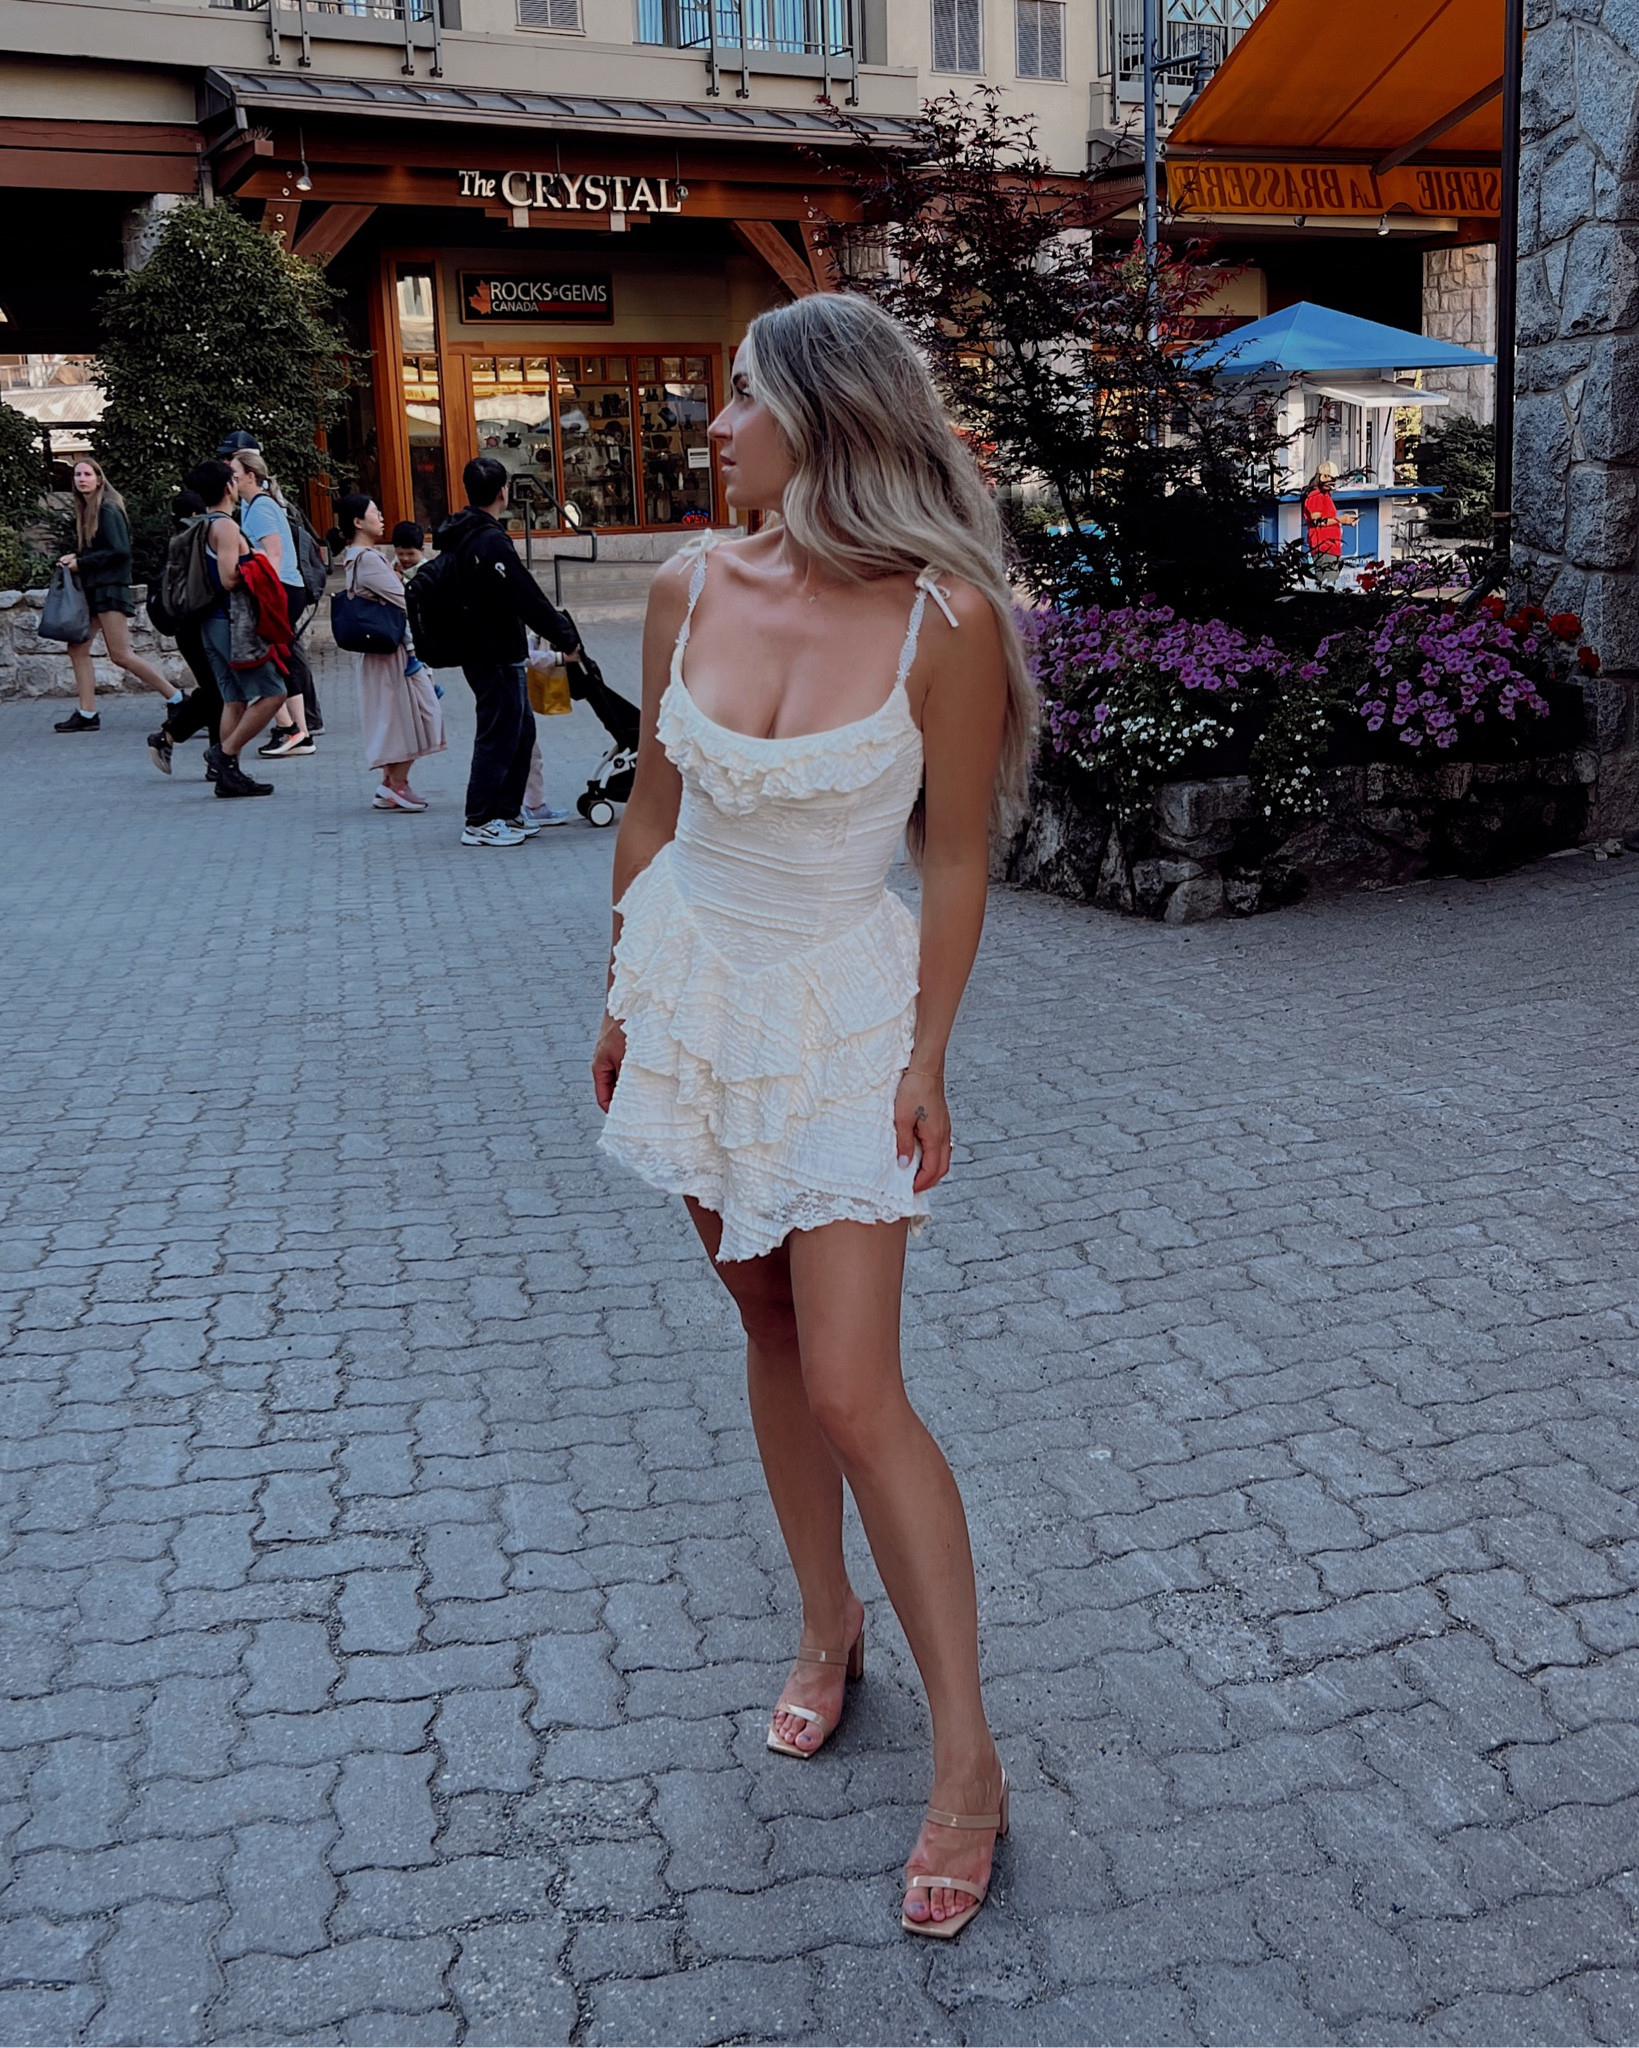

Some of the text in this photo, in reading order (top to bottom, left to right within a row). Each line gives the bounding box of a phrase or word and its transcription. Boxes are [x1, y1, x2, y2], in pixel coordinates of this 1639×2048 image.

[458, 170, 682, 213] The CRYSTAL
[492, 301, 539, 312] CANADA
